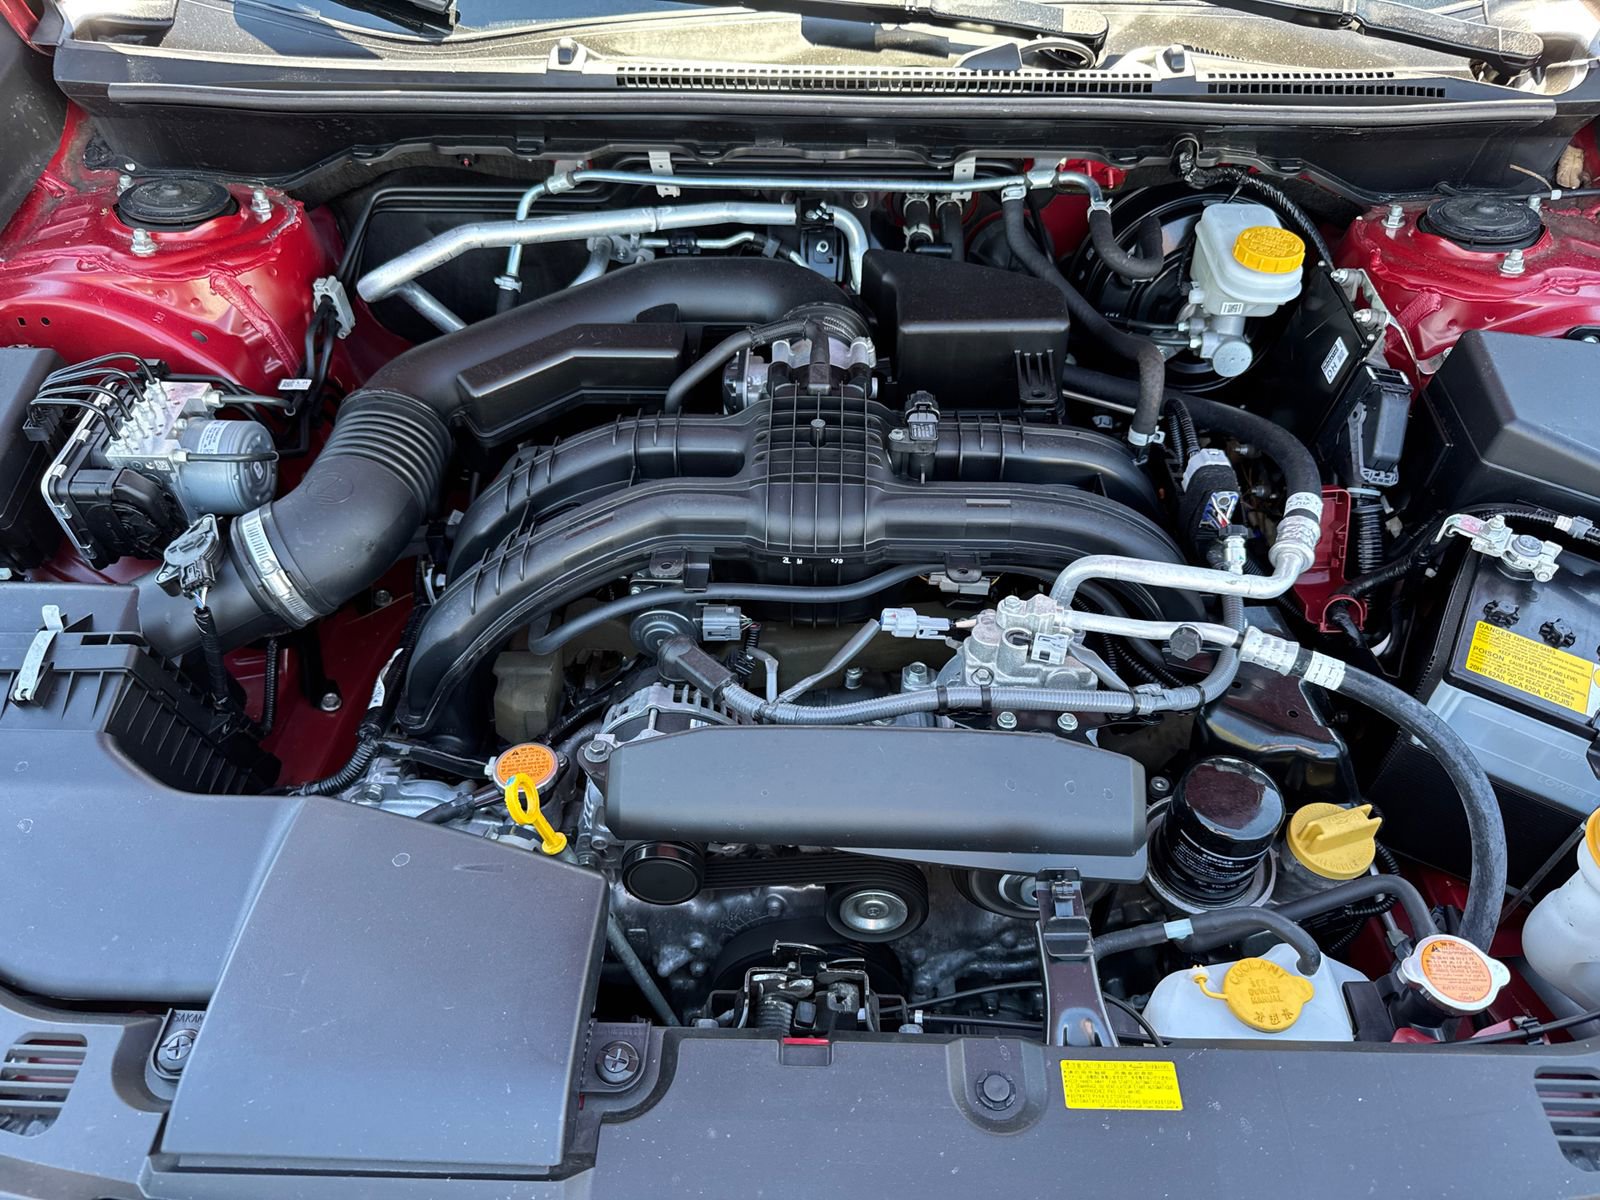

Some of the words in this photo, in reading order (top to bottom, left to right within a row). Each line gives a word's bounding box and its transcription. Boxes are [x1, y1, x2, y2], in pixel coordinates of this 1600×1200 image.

[1478, 622, 1511, 638] DANGER
[1513, 636, 1538, 648] EXPLOSIVE
[1539, 645, 1556, 654] GASES
[1472, 645, 1504, 661] POISON
[1508, 659, 1527, 670] CAUSES
[1528, 667, 1546, 677] SEVERE
[1548, 674, 1564, 684] BURNS
[1524, 659, 1537, 667] CAPS
[1538, 664, 1551, 672] TIGHT
[1563, 673, 1578, 682] LEVEL
[1508, 678, 1522, 687] CCA
[1525, 678, 1541, 688] REACH
[1550, 688, 1574, 700] CHILDREN
[1230, 960, 1288, 985] COOLANT
